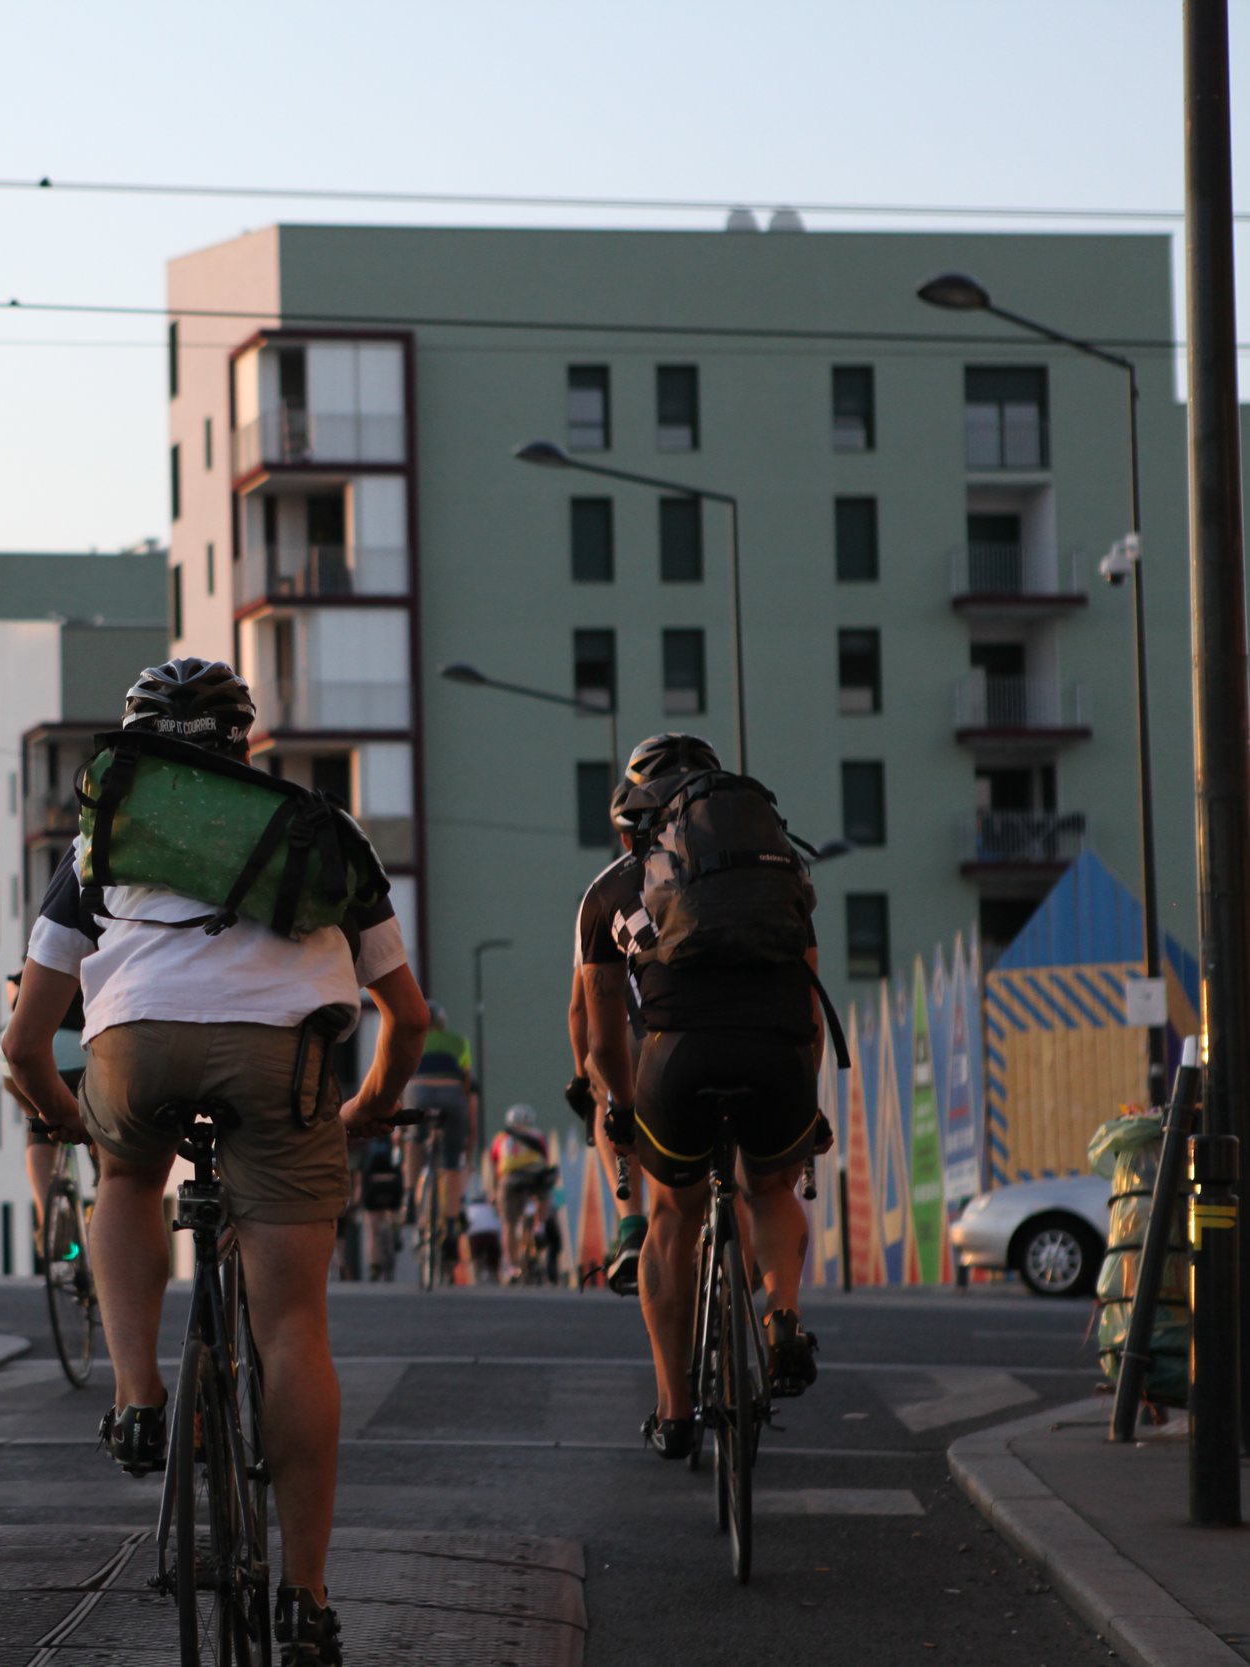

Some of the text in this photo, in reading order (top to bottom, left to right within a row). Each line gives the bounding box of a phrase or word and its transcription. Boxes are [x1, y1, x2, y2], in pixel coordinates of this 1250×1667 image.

[158, 718, 216, 735] DROP IT COURRIER
